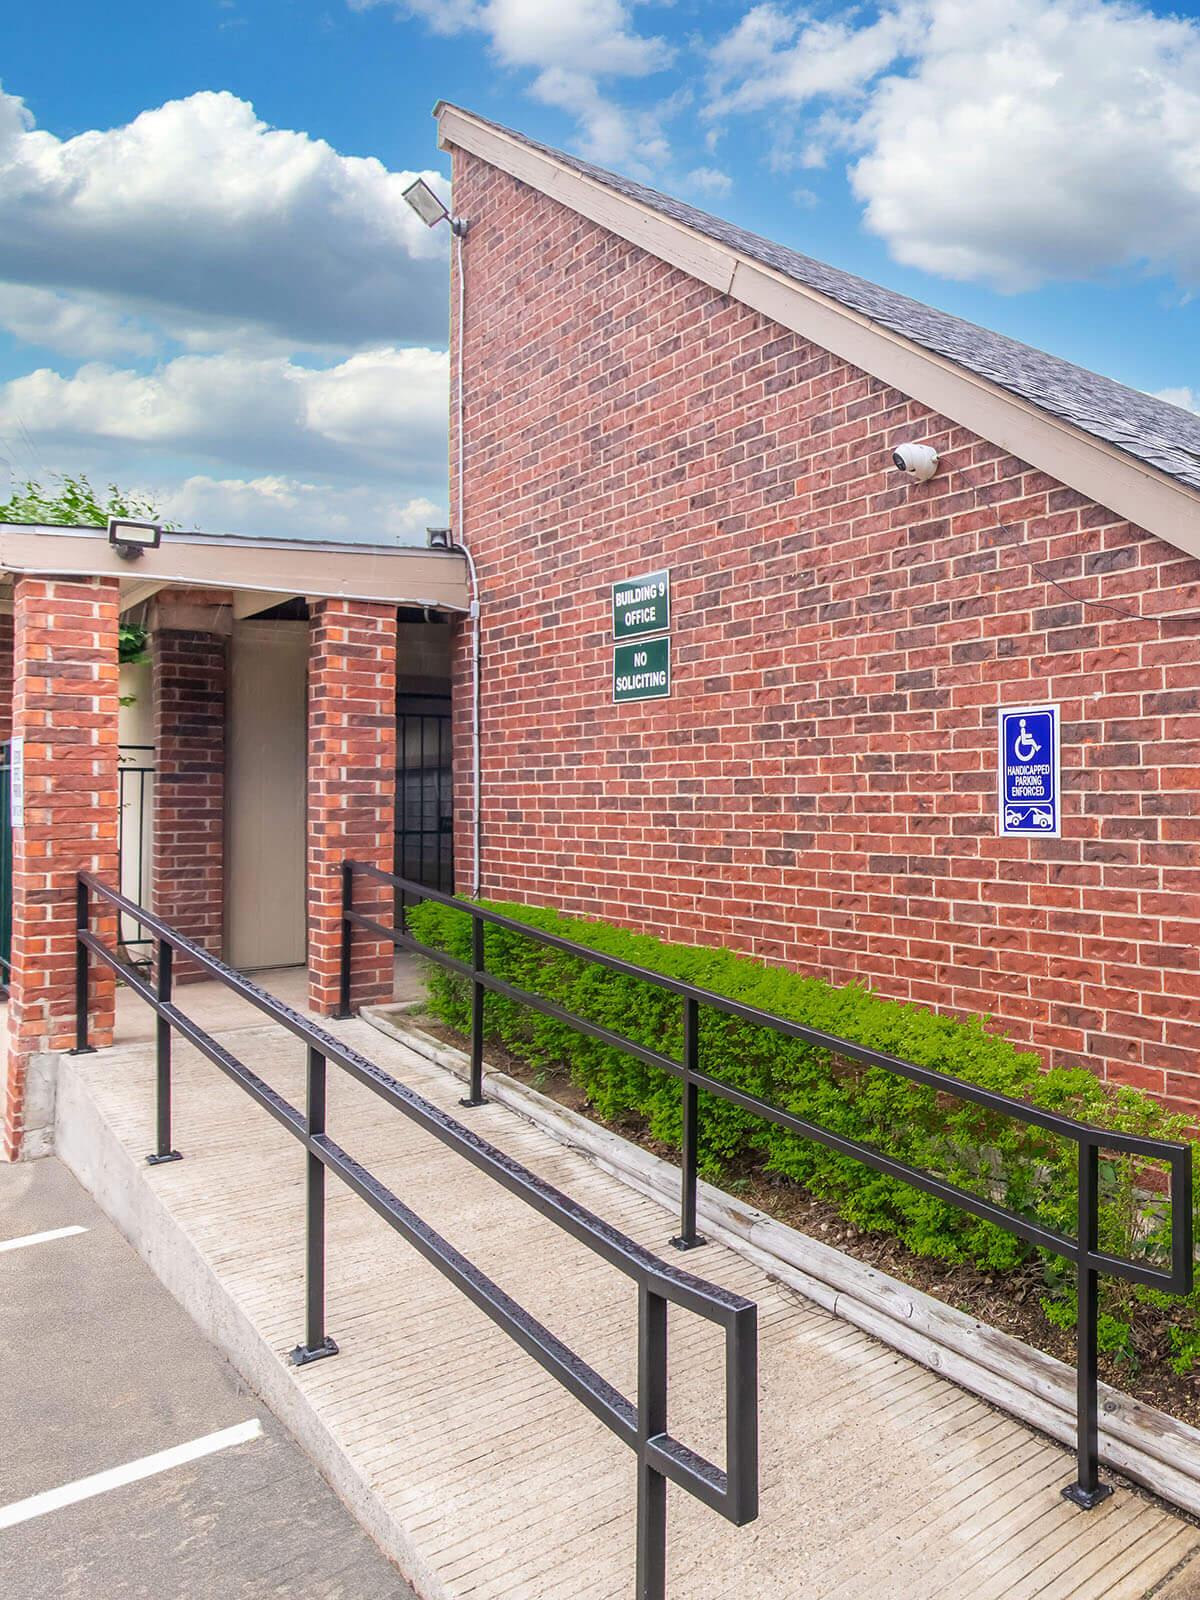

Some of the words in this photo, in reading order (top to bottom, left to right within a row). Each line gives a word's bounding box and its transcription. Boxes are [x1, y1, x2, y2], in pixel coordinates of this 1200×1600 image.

[615, 584, 657, 607] BUILDING
[658, 582, 665, 597] 9
[624, 606, 656, 626] OFFICE
[633, 652, 648, 667] NO
[616, 670, 666, 691] SOLICITING
[1007, 764, 1050, 776] HANDICAPPED
[1015, 776, 1042, 787] PARKING
[1011, 786, 1045, 797] ENFORCED
